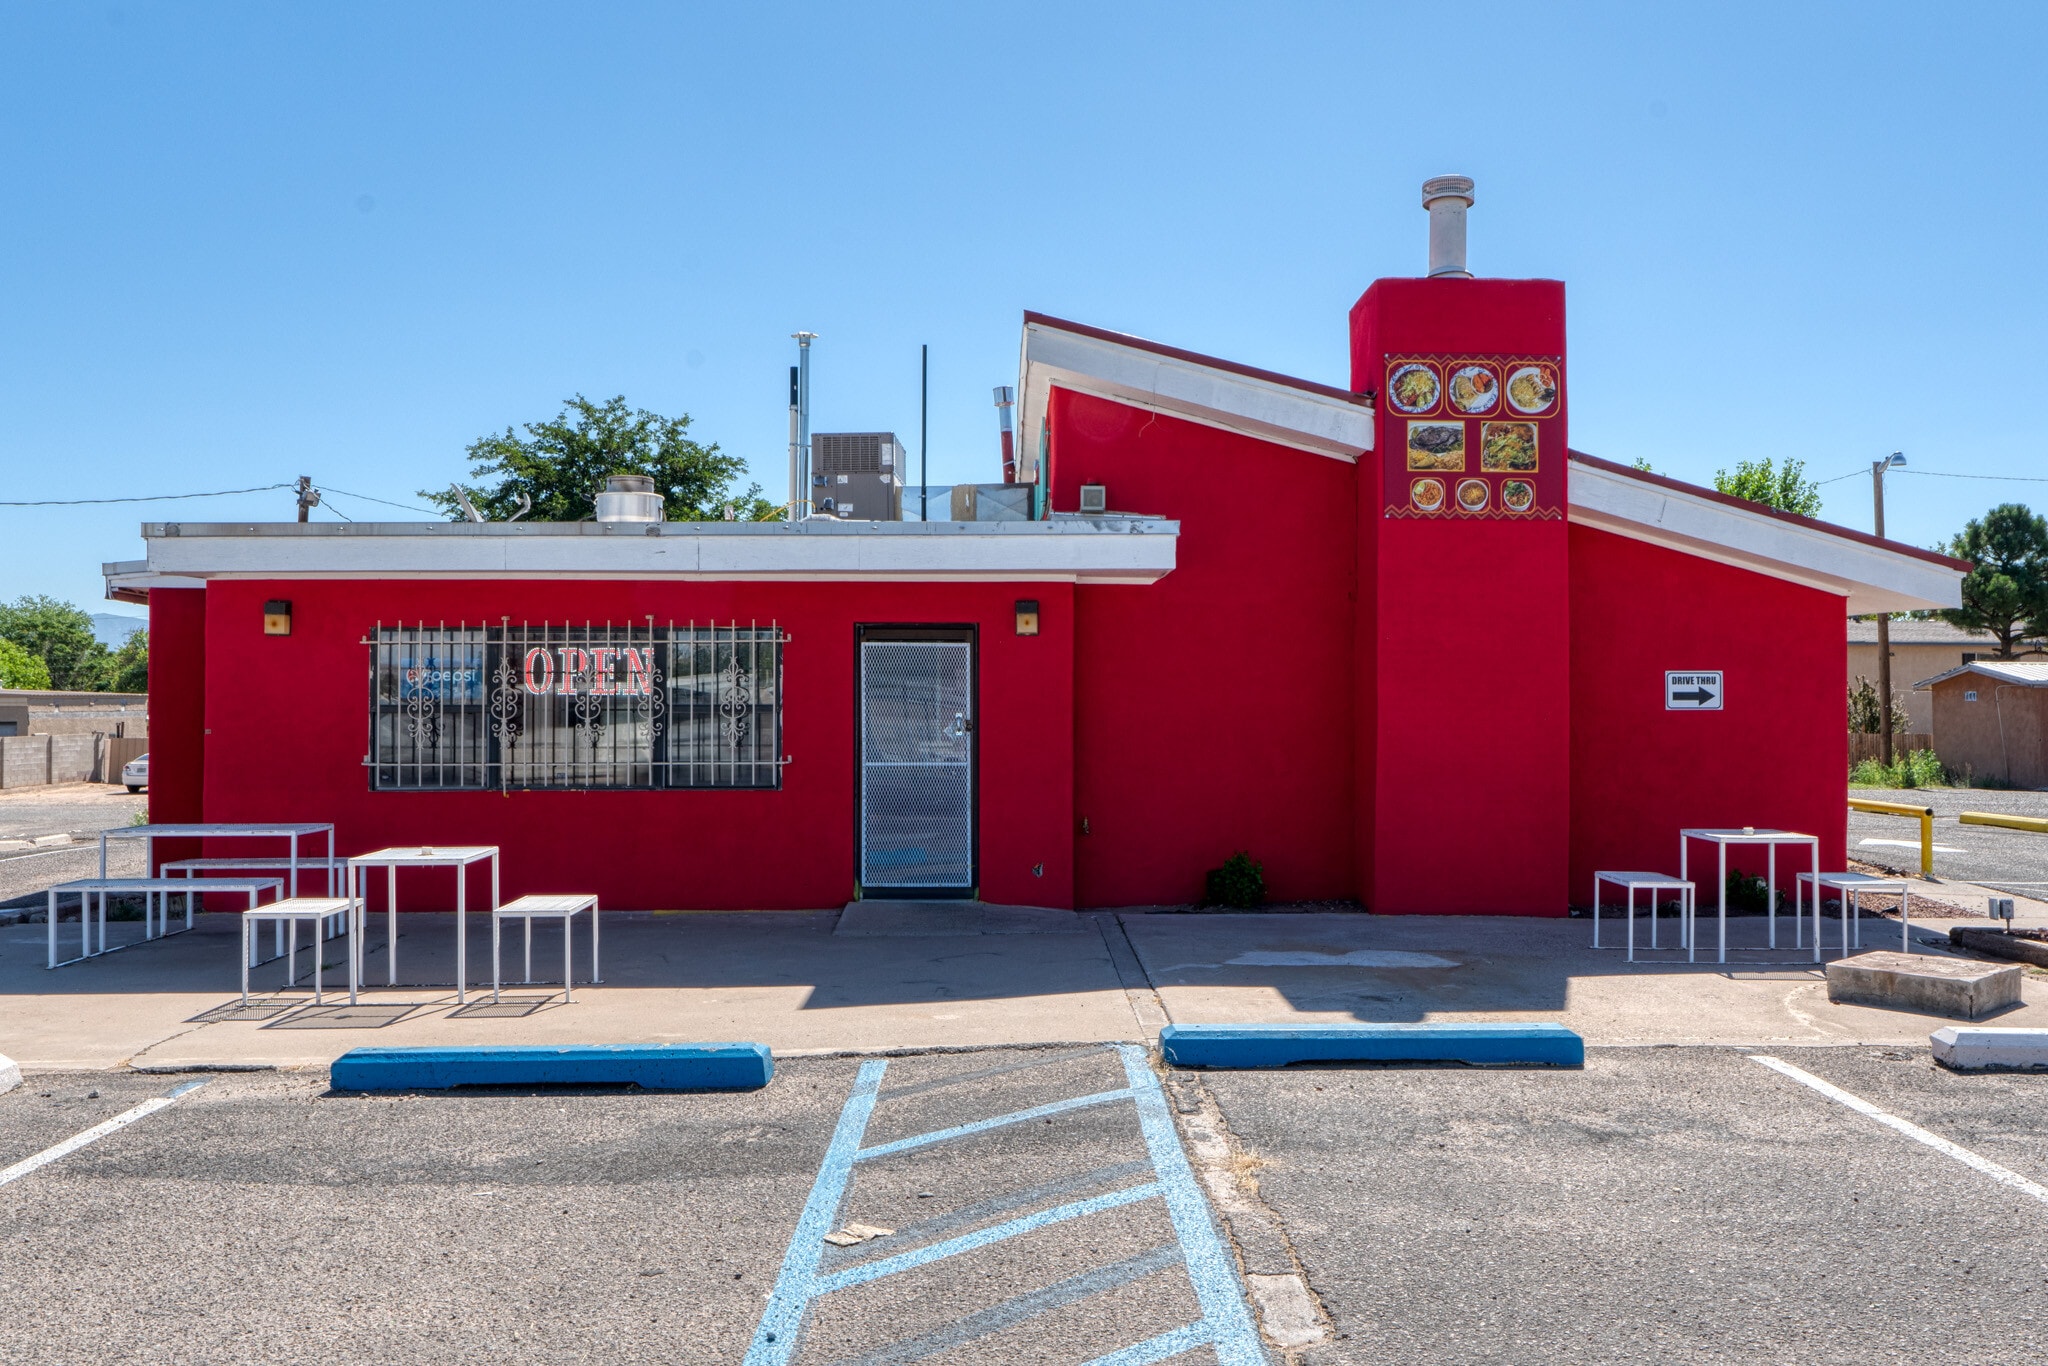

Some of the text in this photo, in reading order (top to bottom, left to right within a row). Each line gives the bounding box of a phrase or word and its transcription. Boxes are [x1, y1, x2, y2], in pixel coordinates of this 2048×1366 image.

[431, 669, 476, 684] pepsi
[525, 647, 655, 696] OPEN
[1671, 676, 1717, 685] DRIVE THRU
